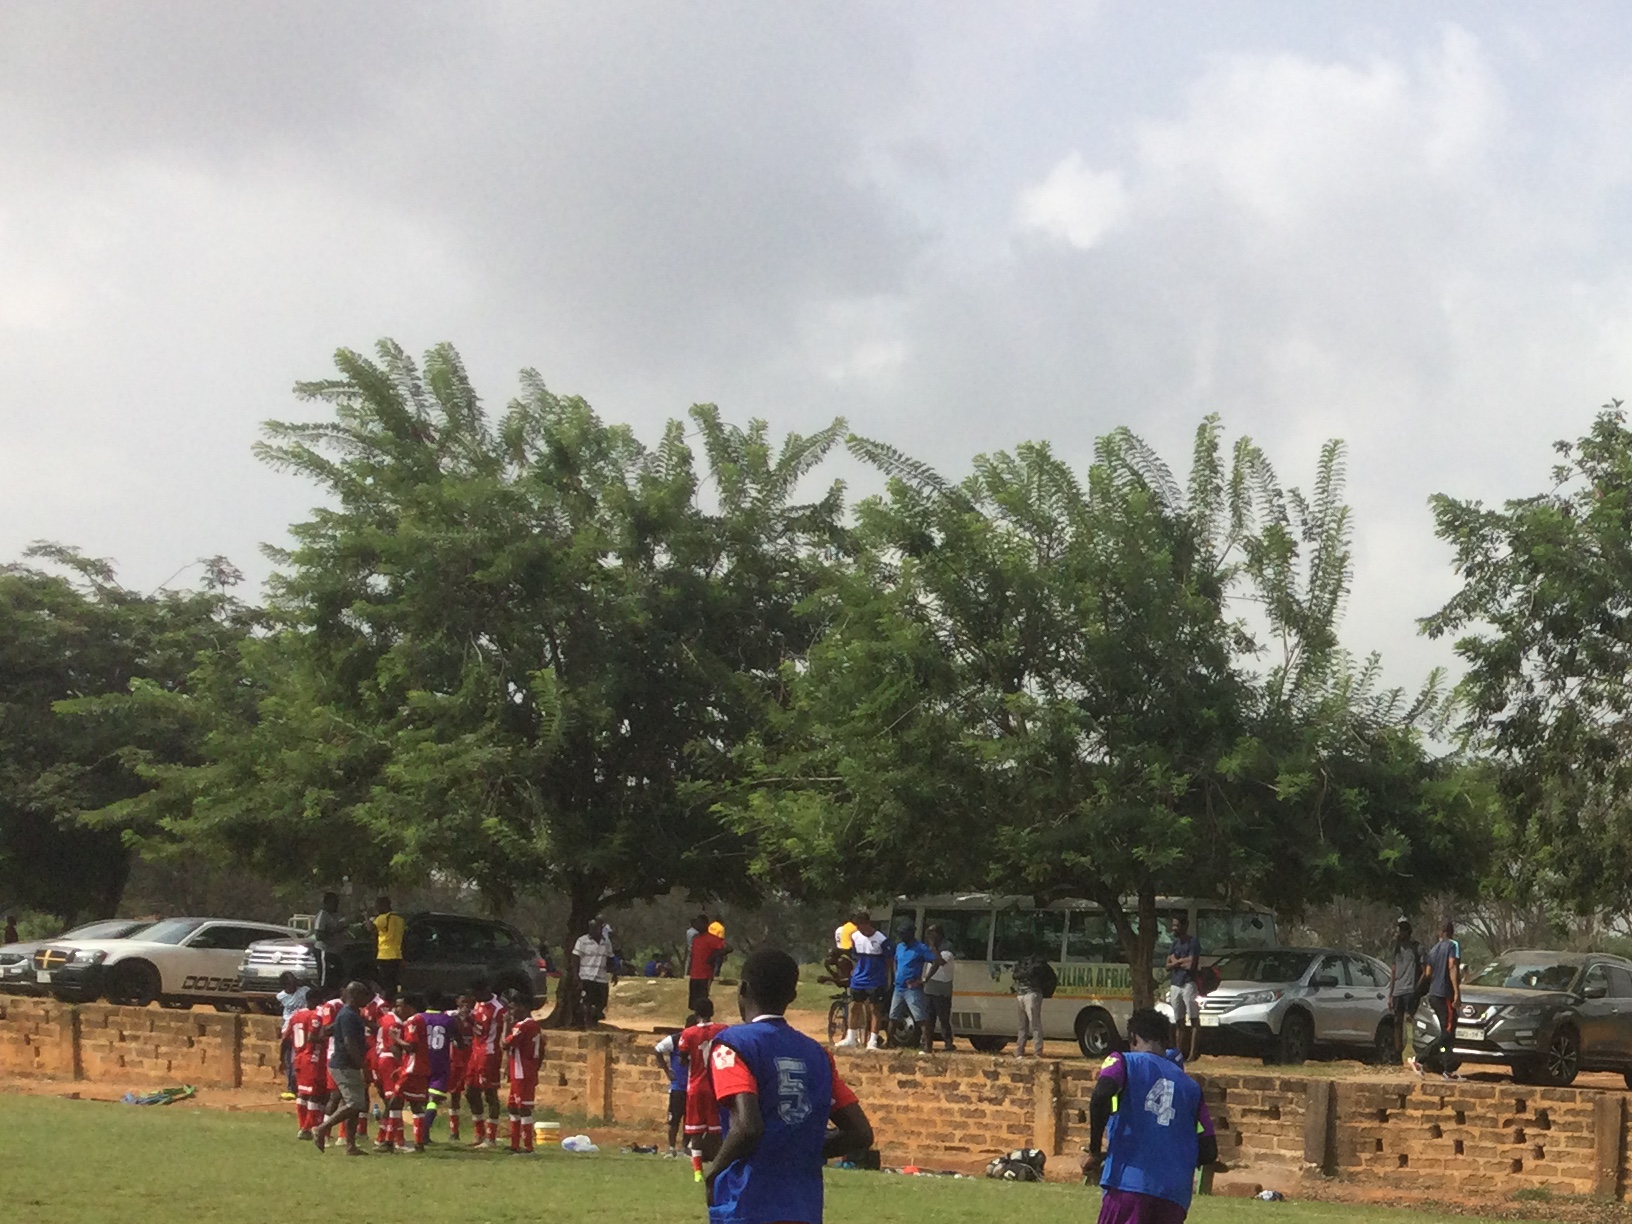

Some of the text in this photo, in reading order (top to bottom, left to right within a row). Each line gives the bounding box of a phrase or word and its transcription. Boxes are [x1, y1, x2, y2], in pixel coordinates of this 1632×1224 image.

[1096, 968, 1133, 988] AFRIC
[427, 1025, 446, 1050] 16
[774, 1056, 813, 1125] 5
[1144, 1078, 1176, 1126] 4
